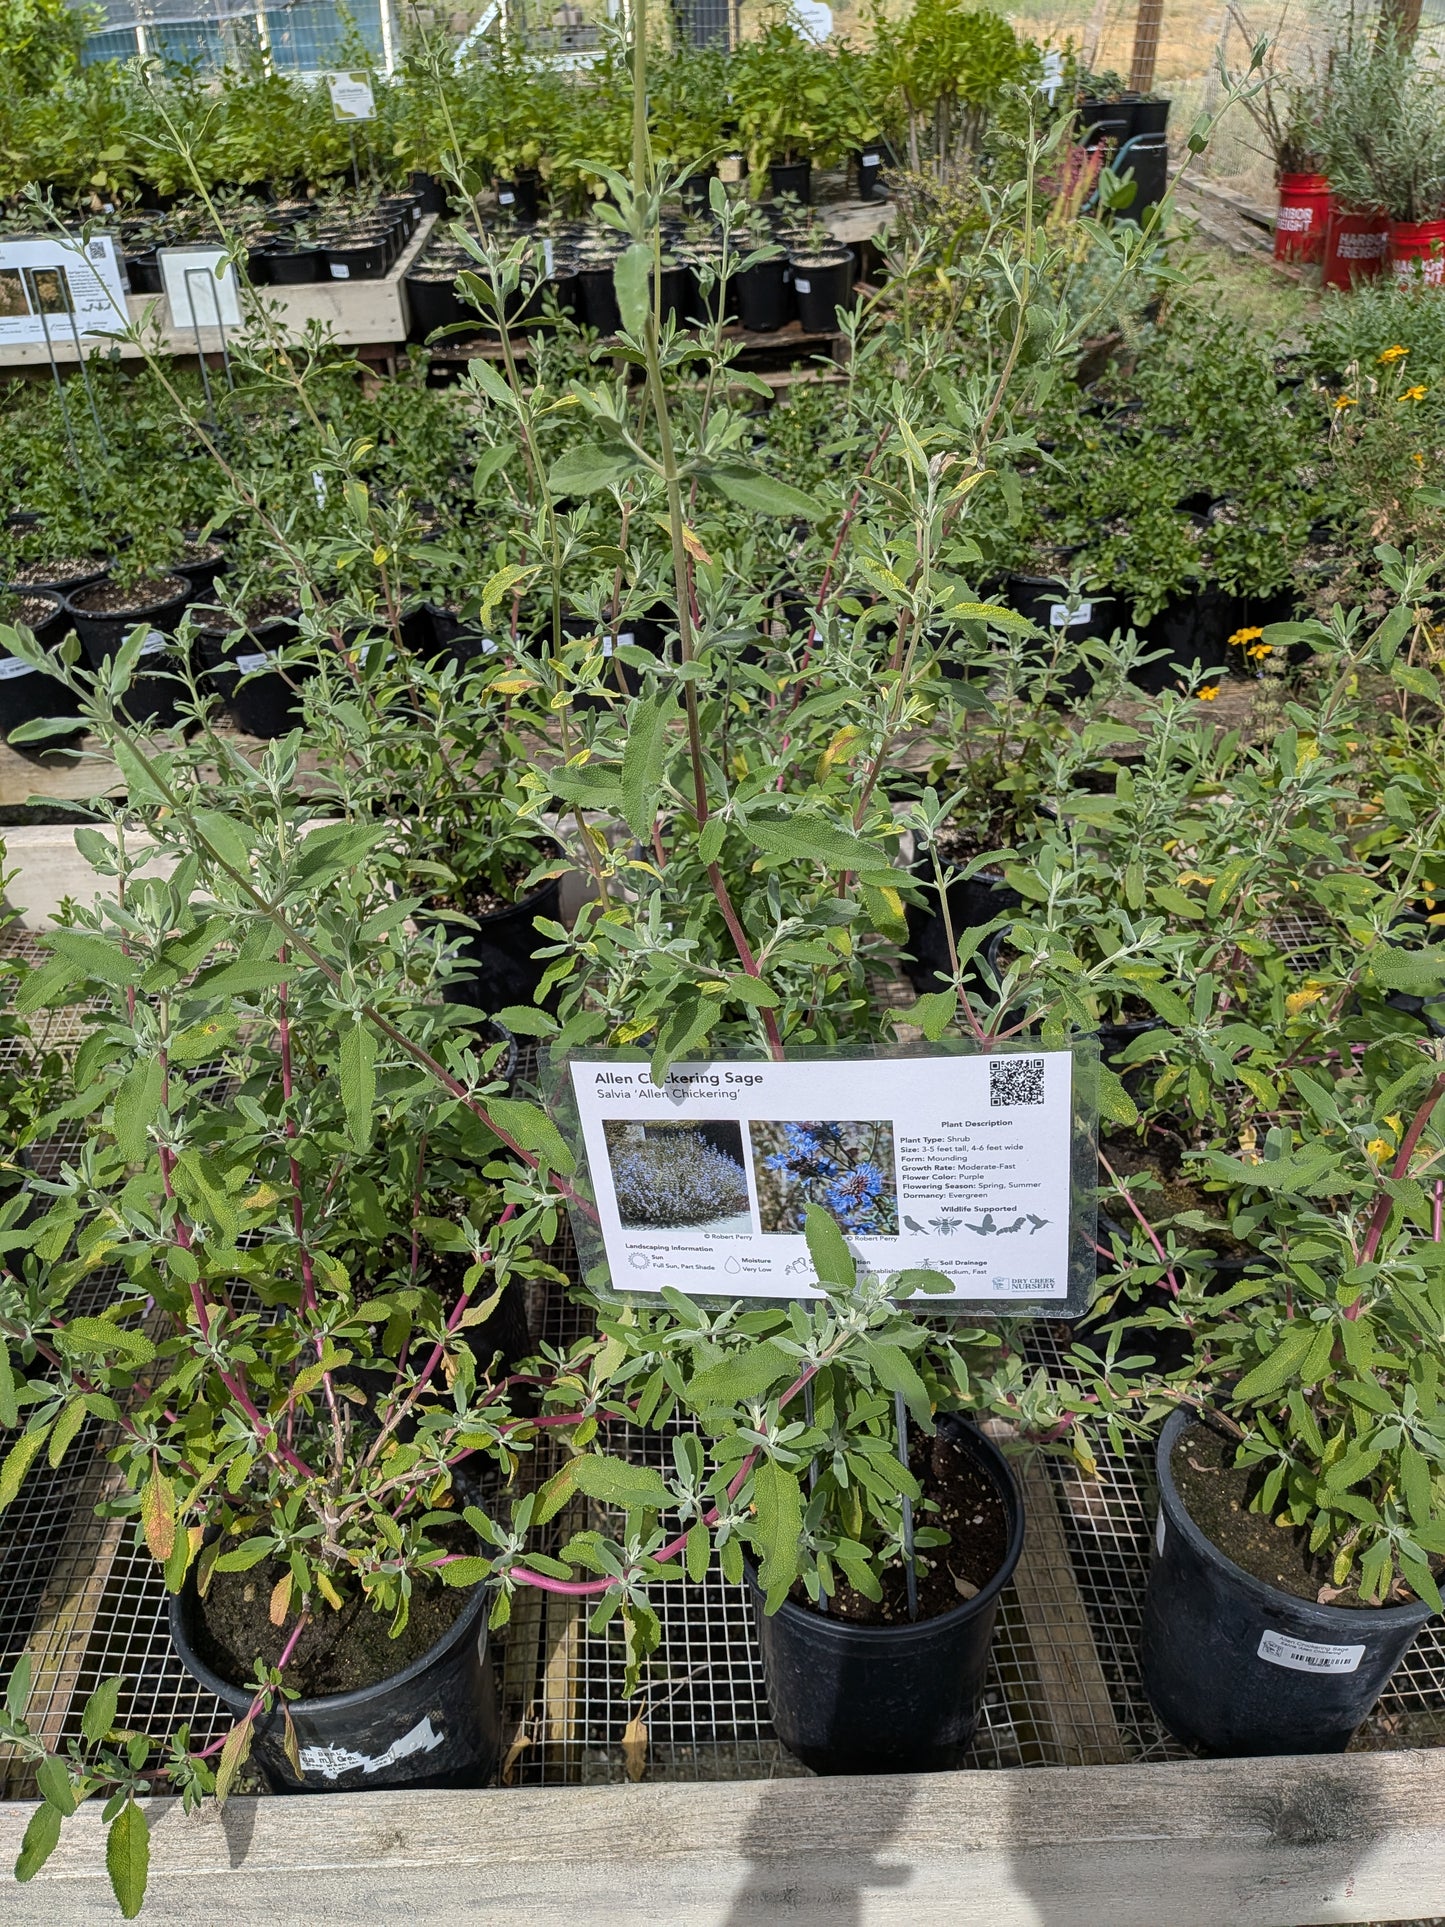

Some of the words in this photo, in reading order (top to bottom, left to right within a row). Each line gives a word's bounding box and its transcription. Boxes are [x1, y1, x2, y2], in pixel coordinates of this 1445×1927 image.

[595, 1072, 633, 1084] Allen
[638, 1072, 720, 1086] Cckering
[724, 1072, 764, 1086] Sage
[597, 1089, 631, 1099] Salvia
[965, 1120, 1013, 1128] Description
[955, 1145, 969, 1153] tall,
[625, 1243, 669, 1251] Landscaping
